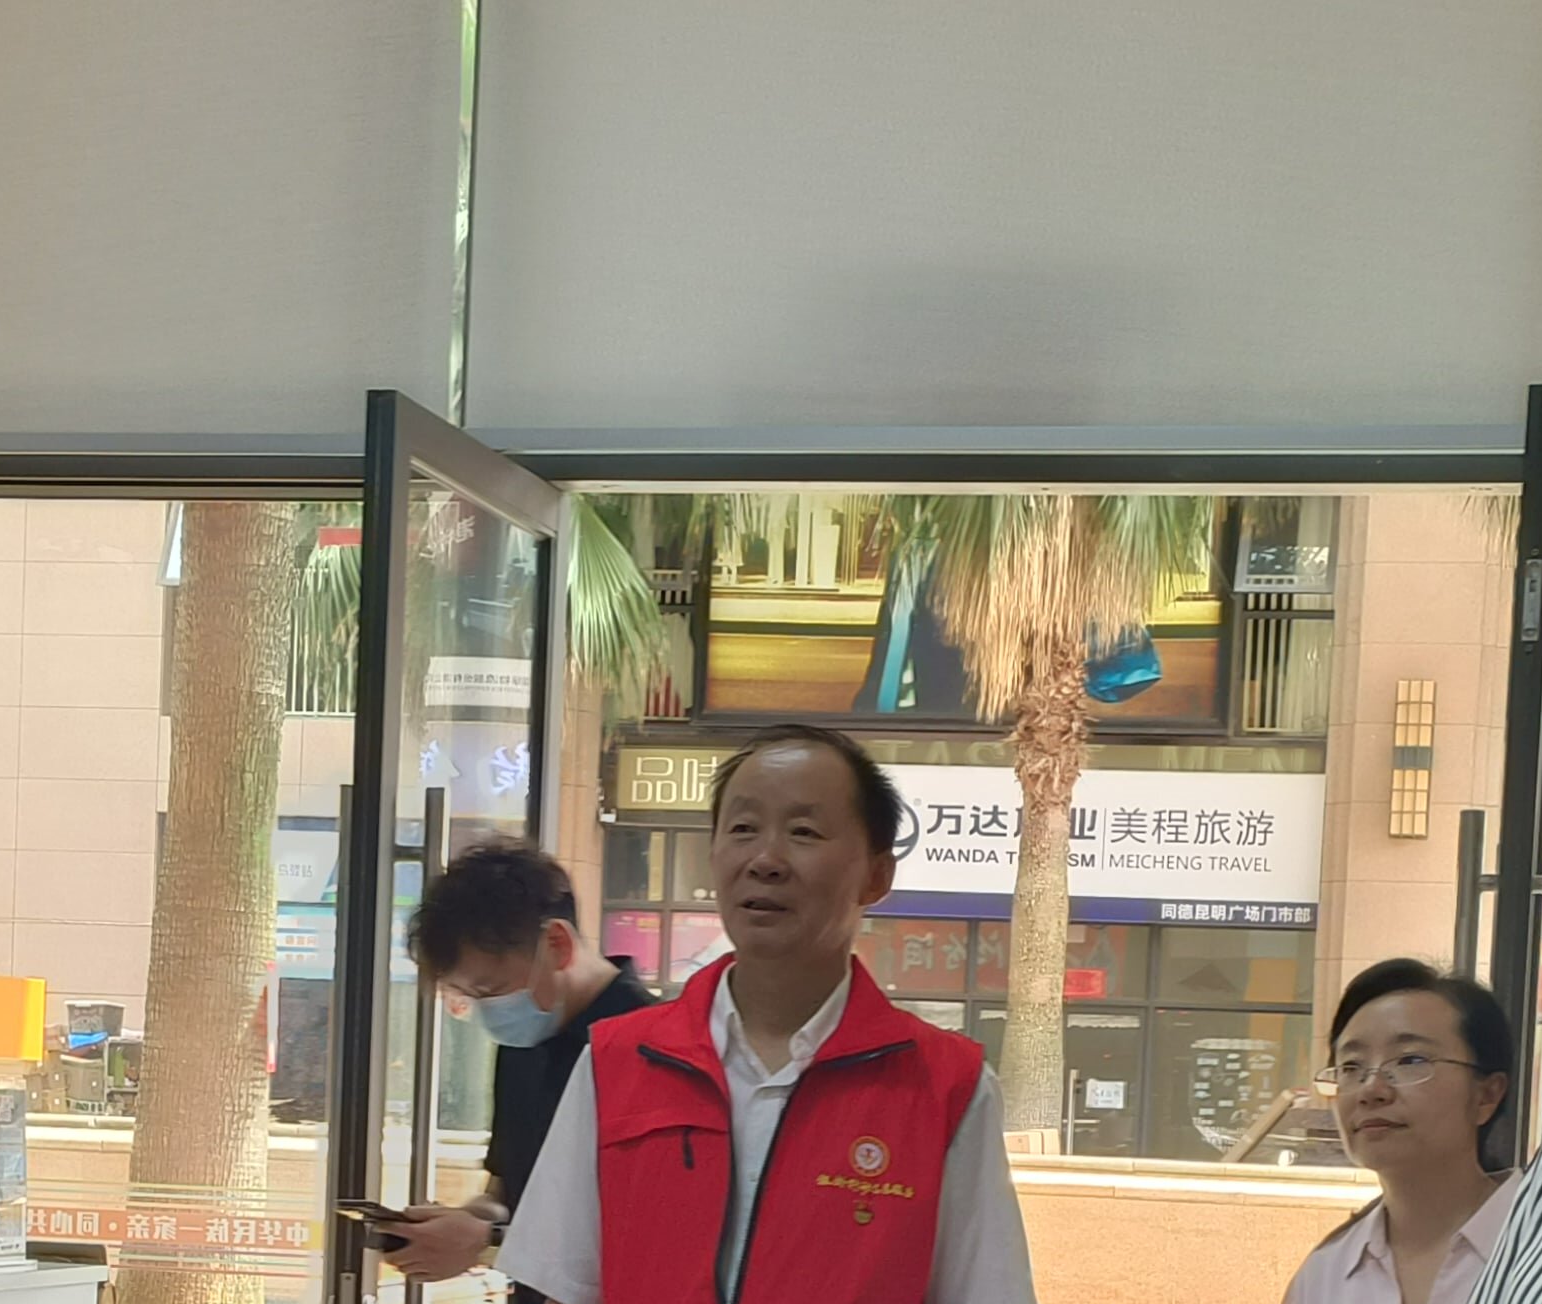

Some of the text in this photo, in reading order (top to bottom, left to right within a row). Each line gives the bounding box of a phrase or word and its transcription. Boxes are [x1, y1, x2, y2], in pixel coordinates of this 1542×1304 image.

[926, 804, 1275, 846] 万达业 美程旅游
[925, 848, 1000, 864] WANDA
[1109, 853, 1272, 872] MEICHENG TRAVEL
[1161, 903, 1311, 924] 同德昆明广场门市部
